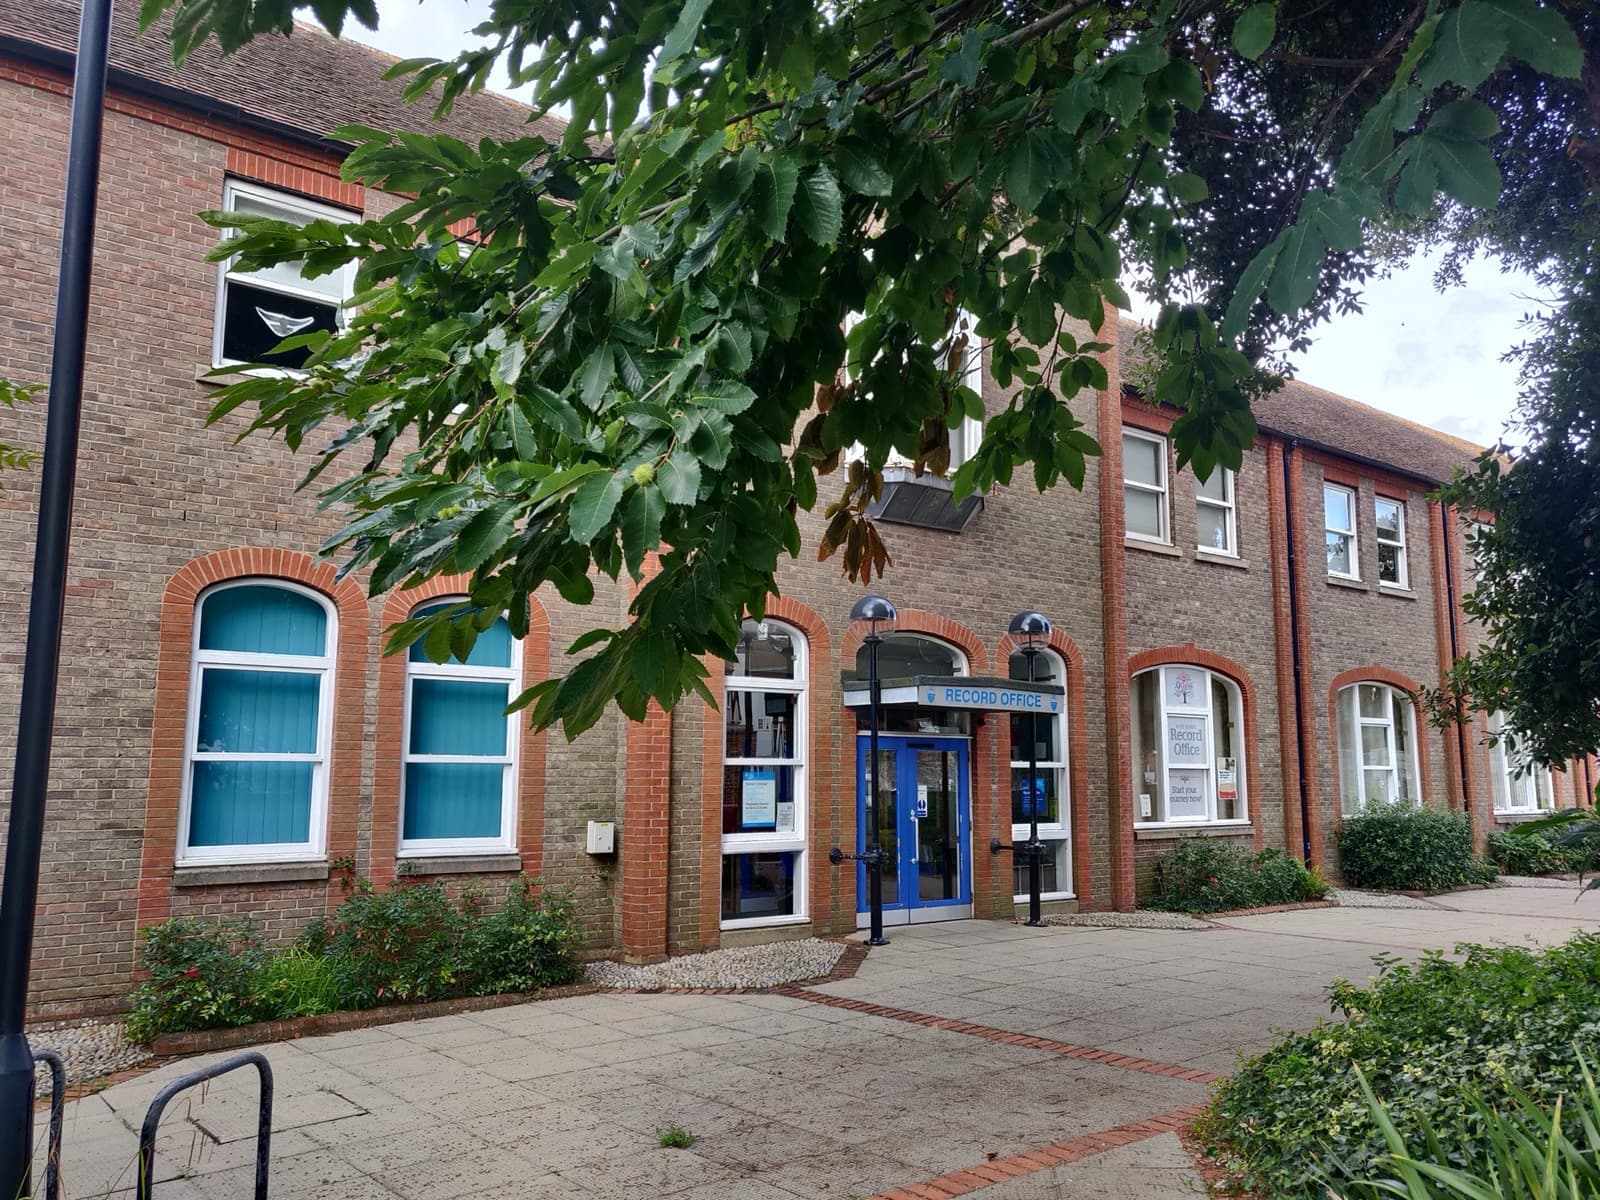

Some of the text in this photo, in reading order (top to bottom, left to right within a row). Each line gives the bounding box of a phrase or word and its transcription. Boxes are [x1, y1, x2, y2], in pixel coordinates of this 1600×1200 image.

[946, 688, 1041, 708] RECORD OFFICE
[1170, 728, 1201, 741] Record
[1174, 743, 1200, 756] Office
